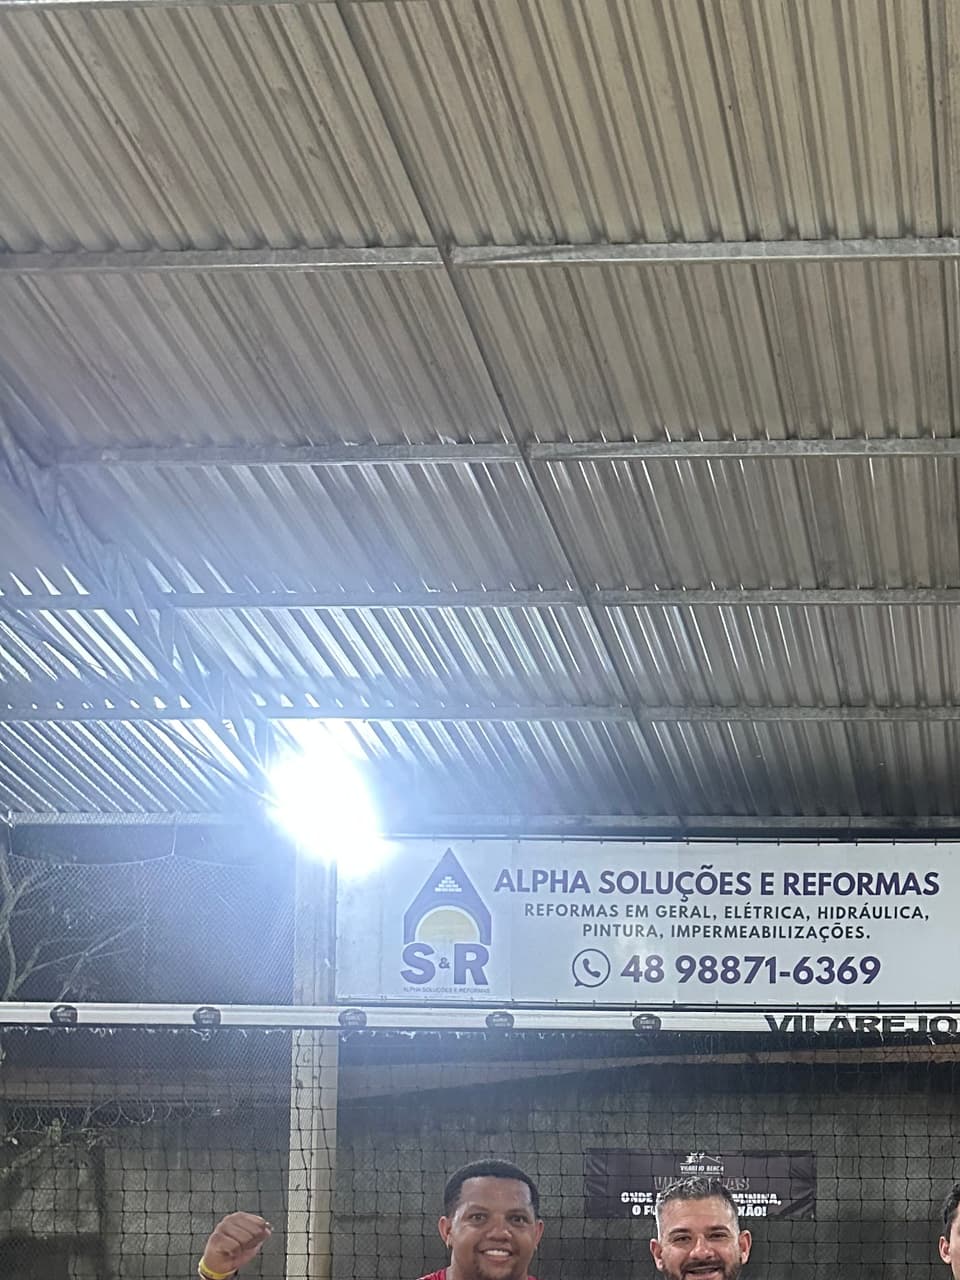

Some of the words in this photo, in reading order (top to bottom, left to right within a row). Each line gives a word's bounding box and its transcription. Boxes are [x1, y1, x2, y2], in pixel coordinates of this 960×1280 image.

[494, 869, 590, 894] ALPHA
[598, 865, 751, 902] SOLUÇÕES
[760, 872, 775, 896] E
[783, 872, 940, 896] REFORMAS
[524, 904, 619, 918] REFORMAS
[625, 905, 649, 918] EM
[655, 905, 718, 921] GERAL,
[724, 902, 811, 921] ELÉTRICA,
[817, 902, 929, 921] HIDRÁULICA,
[583, 924, 664, 939] PINTURA,
[671, 922, 871, 943] IMPERMEABILIZAÇÕES.
[620, 955, 665, 983] 48
[675, 955, 881, 985] 98871-6369
[764, 1014, 958, 1035] VILAREJO
[621, 1191, 653, 1203] ONDE
[737, 1203, 767, 1217] XÃO!
